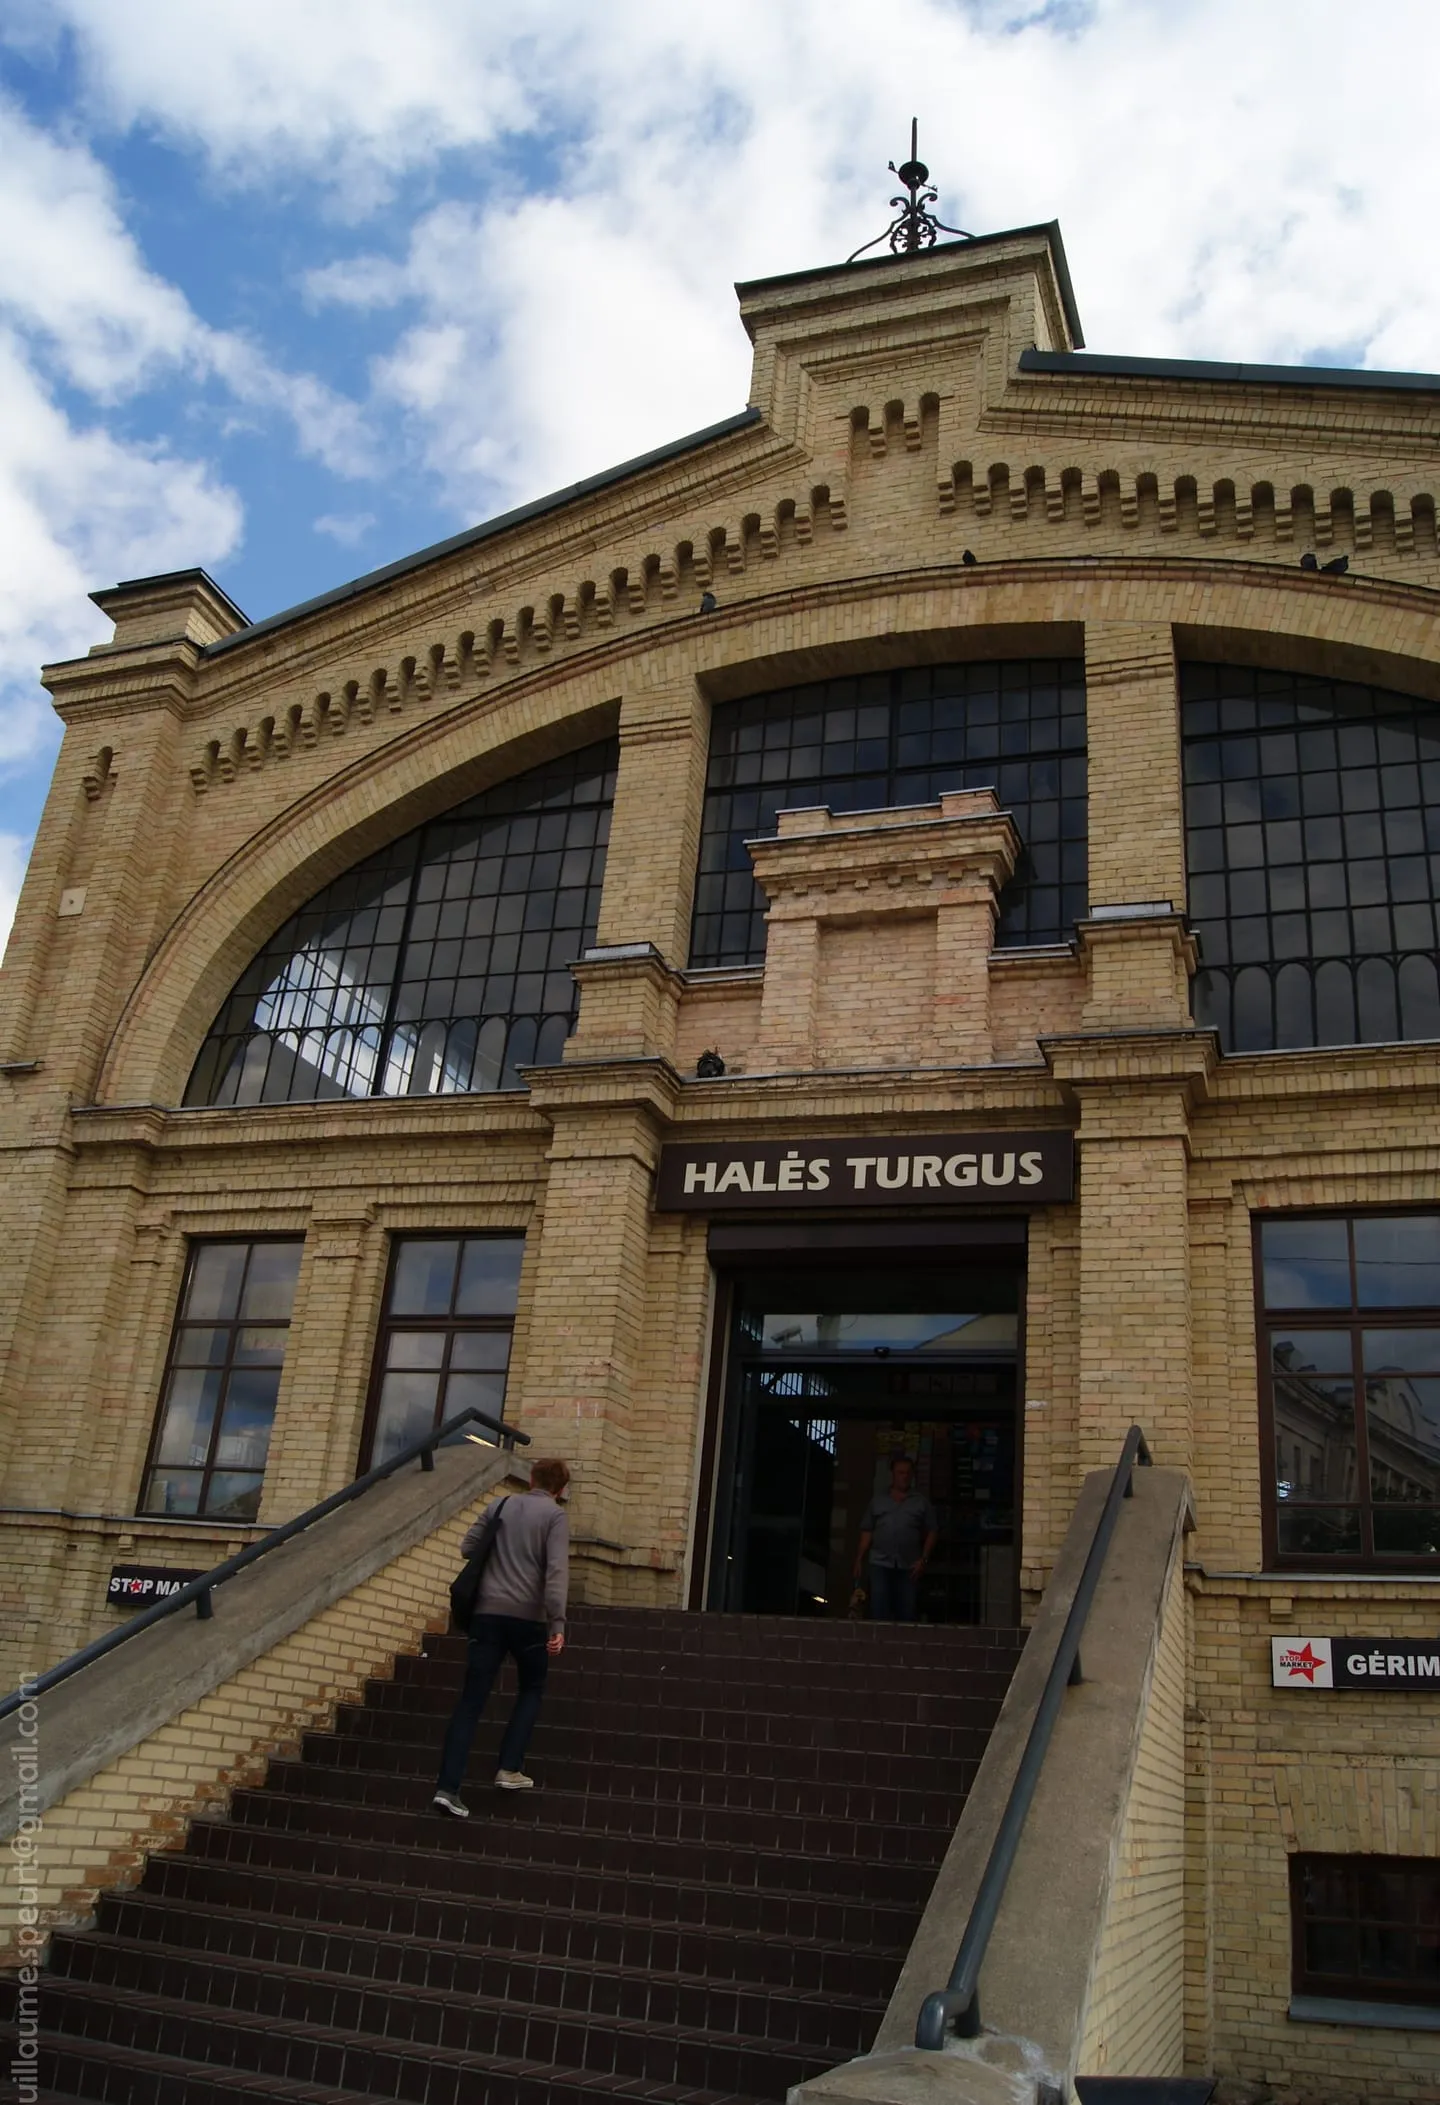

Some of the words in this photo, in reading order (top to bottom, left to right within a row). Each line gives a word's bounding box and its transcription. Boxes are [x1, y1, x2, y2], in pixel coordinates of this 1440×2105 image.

[683, 1151, 830, 1194] HALĖS
[846, 1151, 1043, 1190] TURGUS
[110, 1577, 153, 1594] STOP
[1347, 1650, 1440, 1676] GĖRIM
